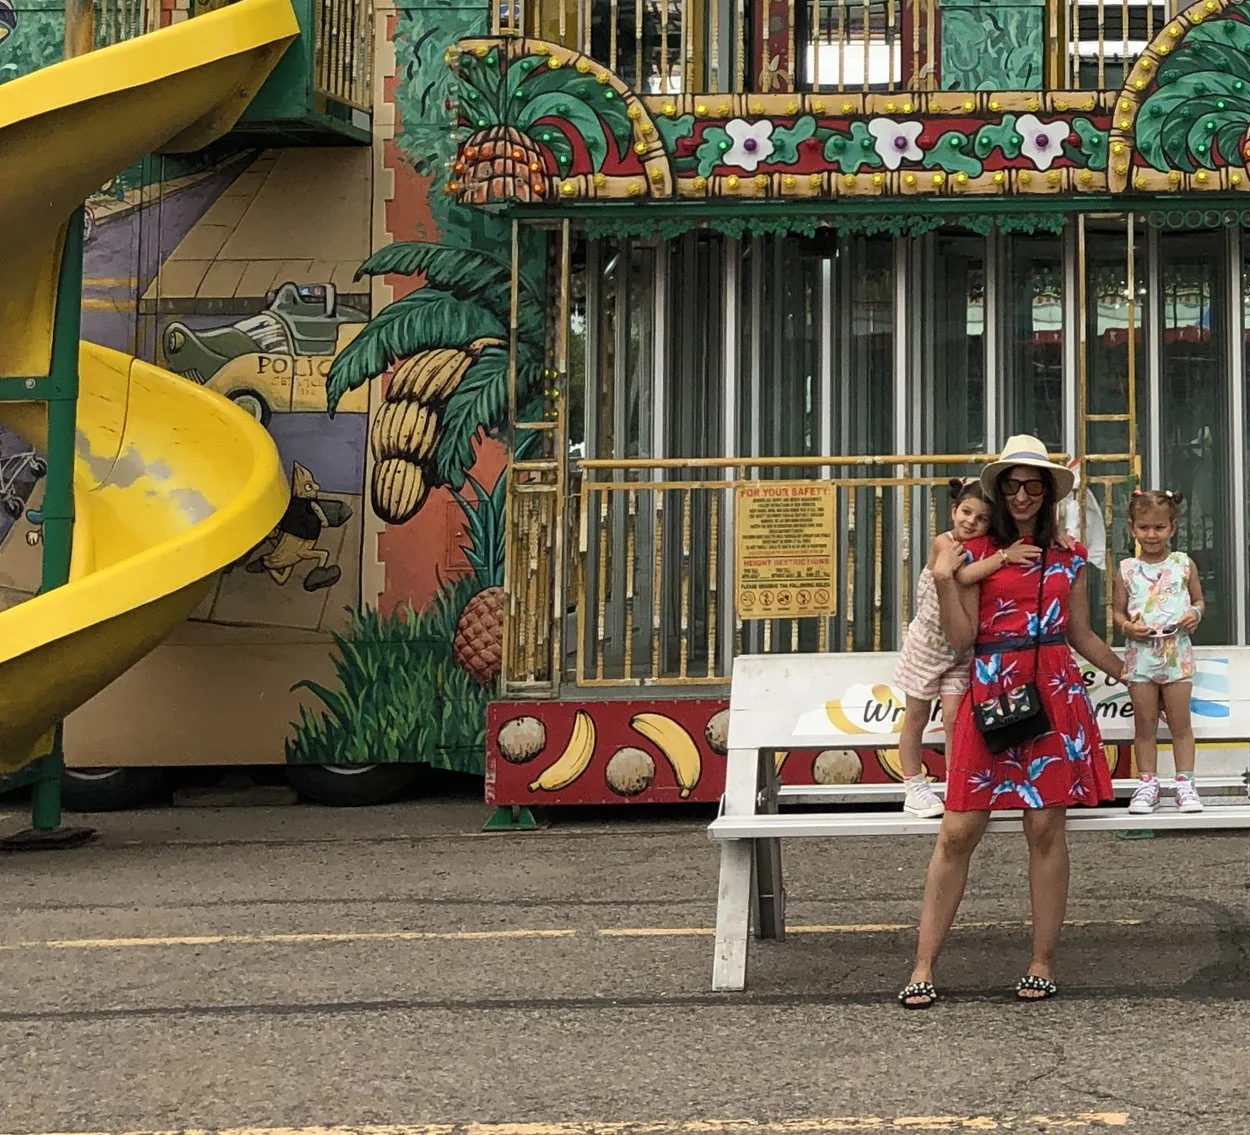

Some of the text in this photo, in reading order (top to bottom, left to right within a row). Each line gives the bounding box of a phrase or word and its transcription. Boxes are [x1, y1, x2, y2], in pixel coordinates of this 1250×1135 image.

[257, 355, 332, 377] POLIC
[740, 488, 759, 497] FOR
[762, 488, 788, 496] YOUR
